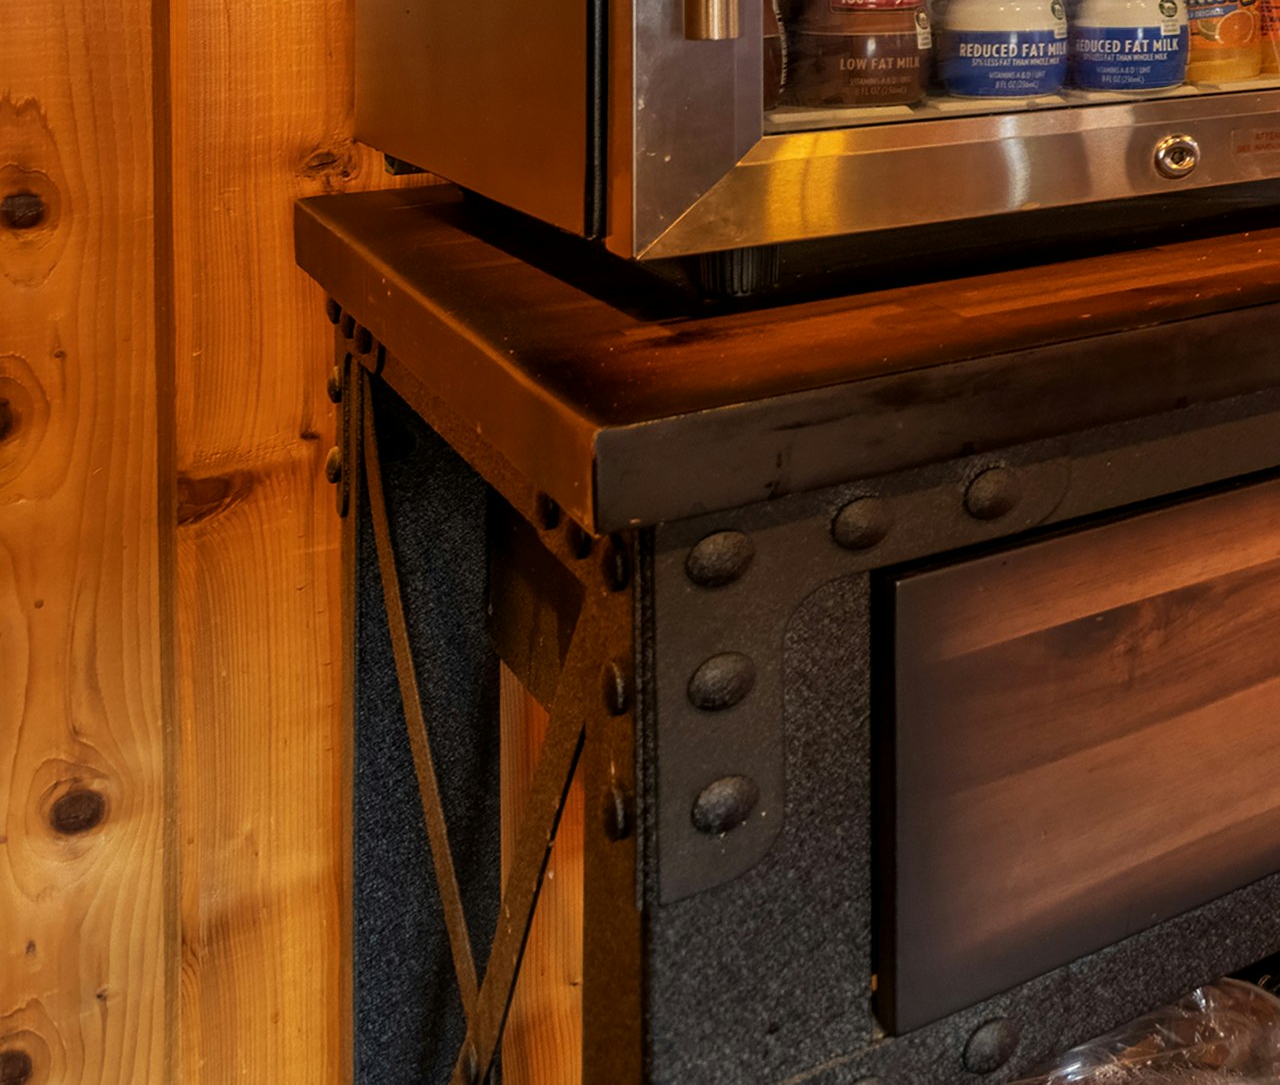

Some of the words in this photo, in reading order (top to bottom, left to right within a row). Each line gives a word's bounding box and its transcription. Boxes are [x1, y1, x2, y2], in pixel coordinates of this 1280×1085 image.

[960, 43, 1018, 57] REDUCED
[1022, 43, 1046, 57] FAT
[1125, 39, 1149, 53] FAT
[1152, 38, 1179, 52] MILK
[839, 58, 867, 71] LOW
[871, 57, 894, 70] FAT
[896, 56, 920, 69] MILK
